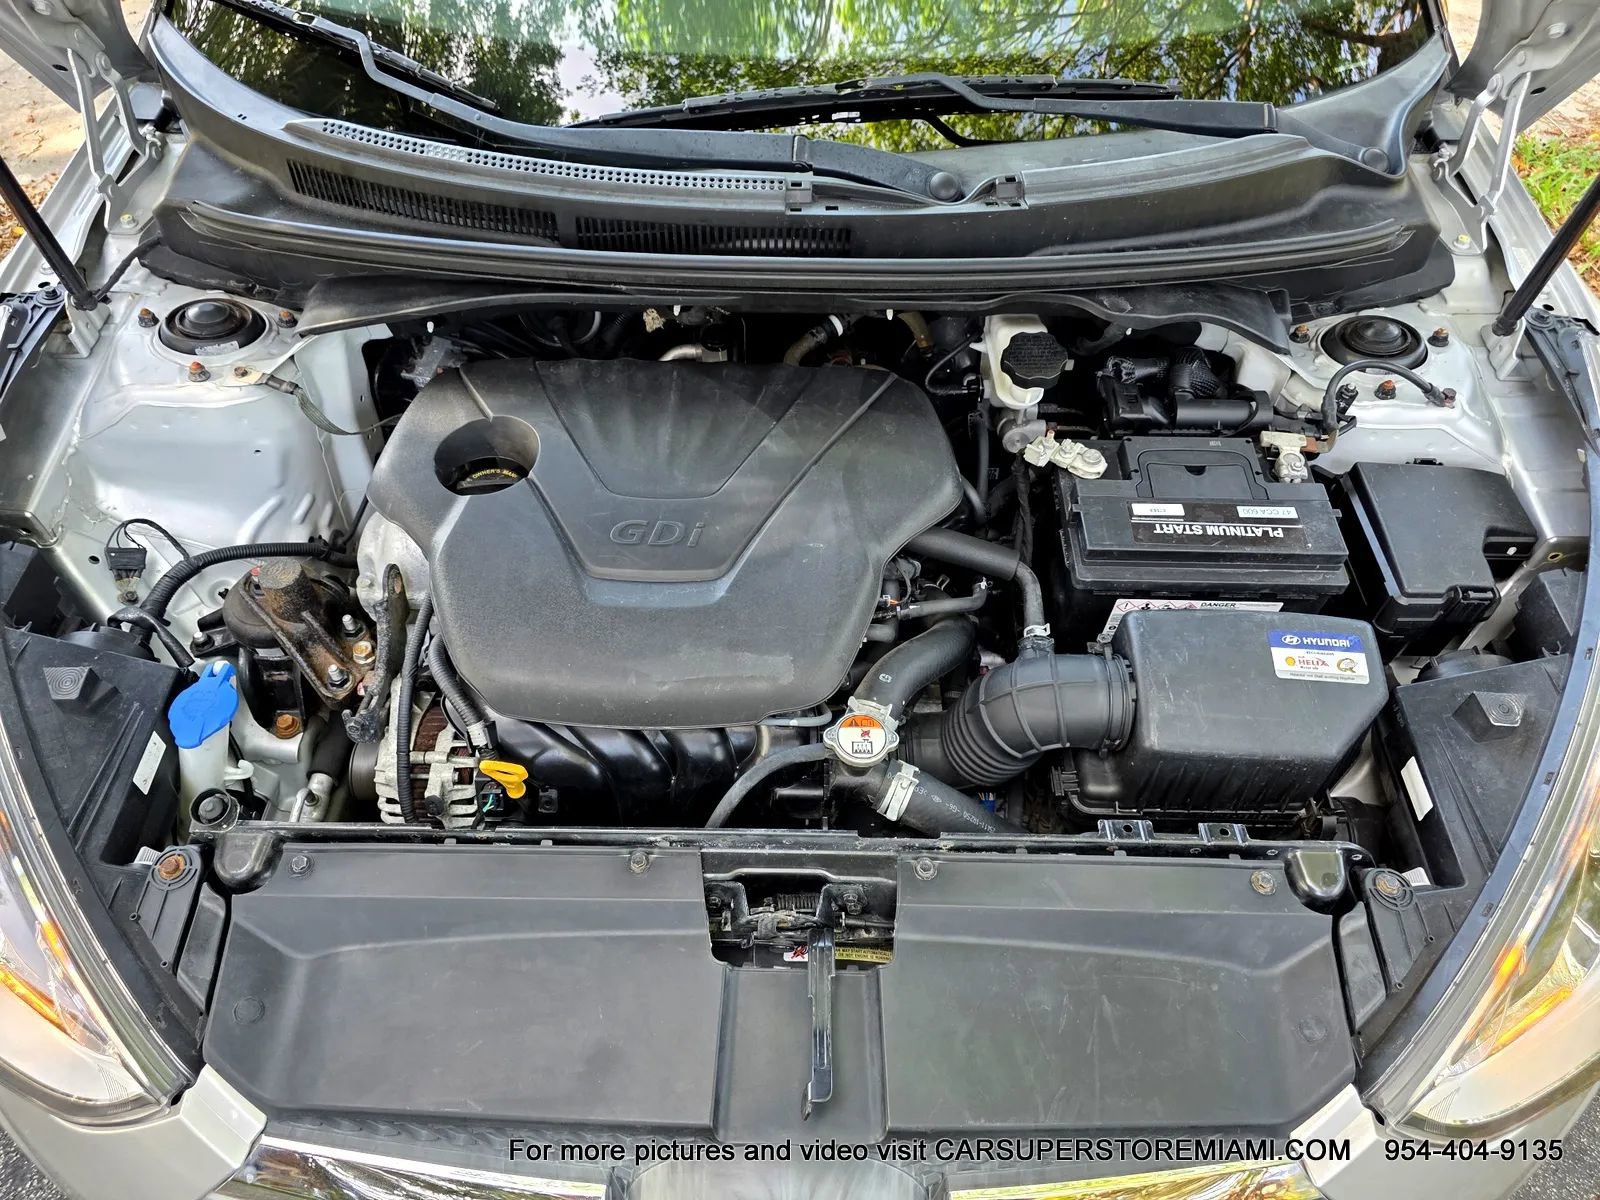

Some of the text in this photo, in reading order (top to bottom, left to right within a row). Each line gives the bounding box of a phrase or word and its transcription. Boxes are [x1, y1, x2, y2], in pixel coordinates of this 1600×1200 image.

[609, 519, 706, 548] GDi
[1153, 523, 1284, 538] PLATINUM START
[1303, 637, 1351, 648] HYUNDAI
[1298, 658, 1330, 667] HELIX
